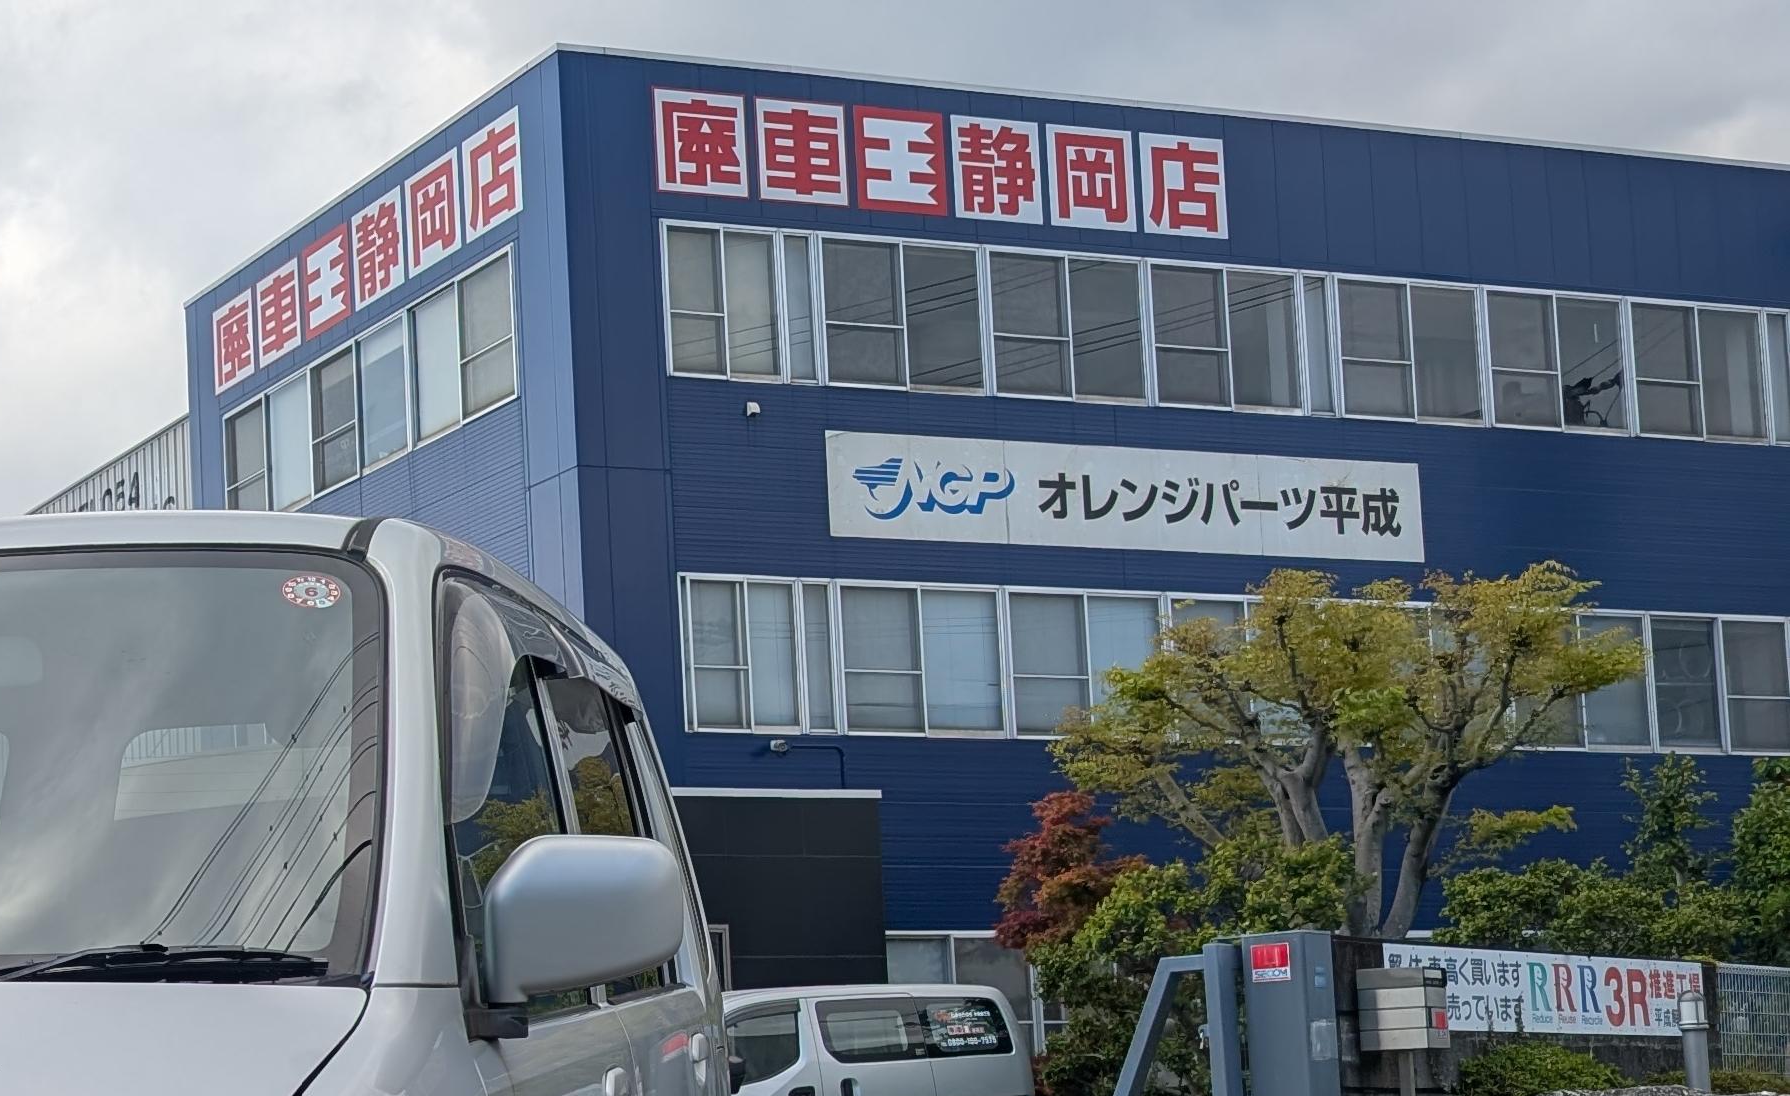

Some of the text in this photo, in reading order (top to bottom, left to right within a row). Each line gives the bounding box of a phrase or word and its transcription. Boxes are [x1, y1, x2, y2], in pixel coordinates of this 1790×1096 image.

[662, 97, 1221, 234] 廃車王静岡店
[214, 118, 520, 388] 廃車王静岡店
[1038, 472, 1404, 537] オレンジパーツ平成
[1531, 1013, 1553, 1025] Reduce
